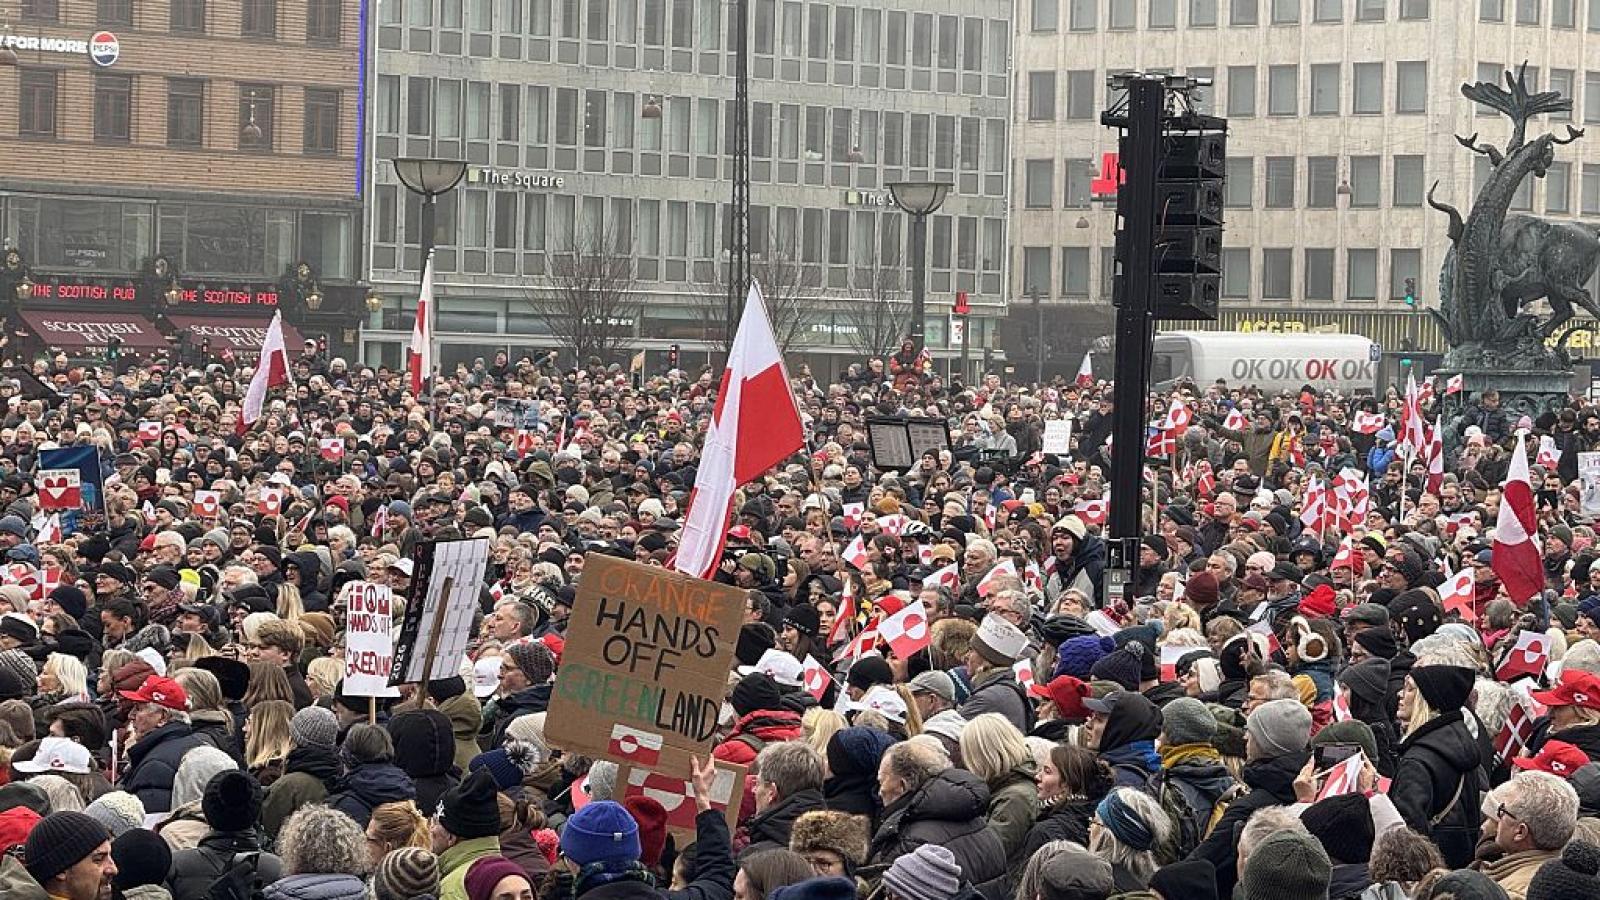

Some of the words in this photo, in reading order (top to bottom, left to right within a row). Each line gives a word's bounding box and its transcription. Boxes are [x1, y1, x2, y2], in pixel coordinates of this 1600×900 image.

[6, 35, 40, 50] FOR
[40, 38, 88, 54] MORE
[482, 169, 508, 184] The
[515, 172, 564, 189] Square
[860, 191, 883, 205] The
[32, 285, 52, 298] THE
[58, 285, 107, 299] SCOTTISH
[113, 287, 136, 300] PUB
[180, 289, 198, 302] THE
[204, 290, 251, 304] SCOTTISH
[257, 292, 278, 305] PUB
[42, 320, 144, 334] SCOTTISH
[190, 324, 269, 338] SCOTTIS
[1231, 359, 1267, 380] OK
[1268, 359, 1303, 380] OK
[1305, 359, 1339, 380] OK
[1341, 359, 1373, 380] OK
[347, 613, 379, 634] HANDS
[596, 597, 719, 658] HANDS
[389, 644, 408, 680] 2026
[602, 634, 681, 681] OFF
[557, 663, 720, 742] GREENLAND
